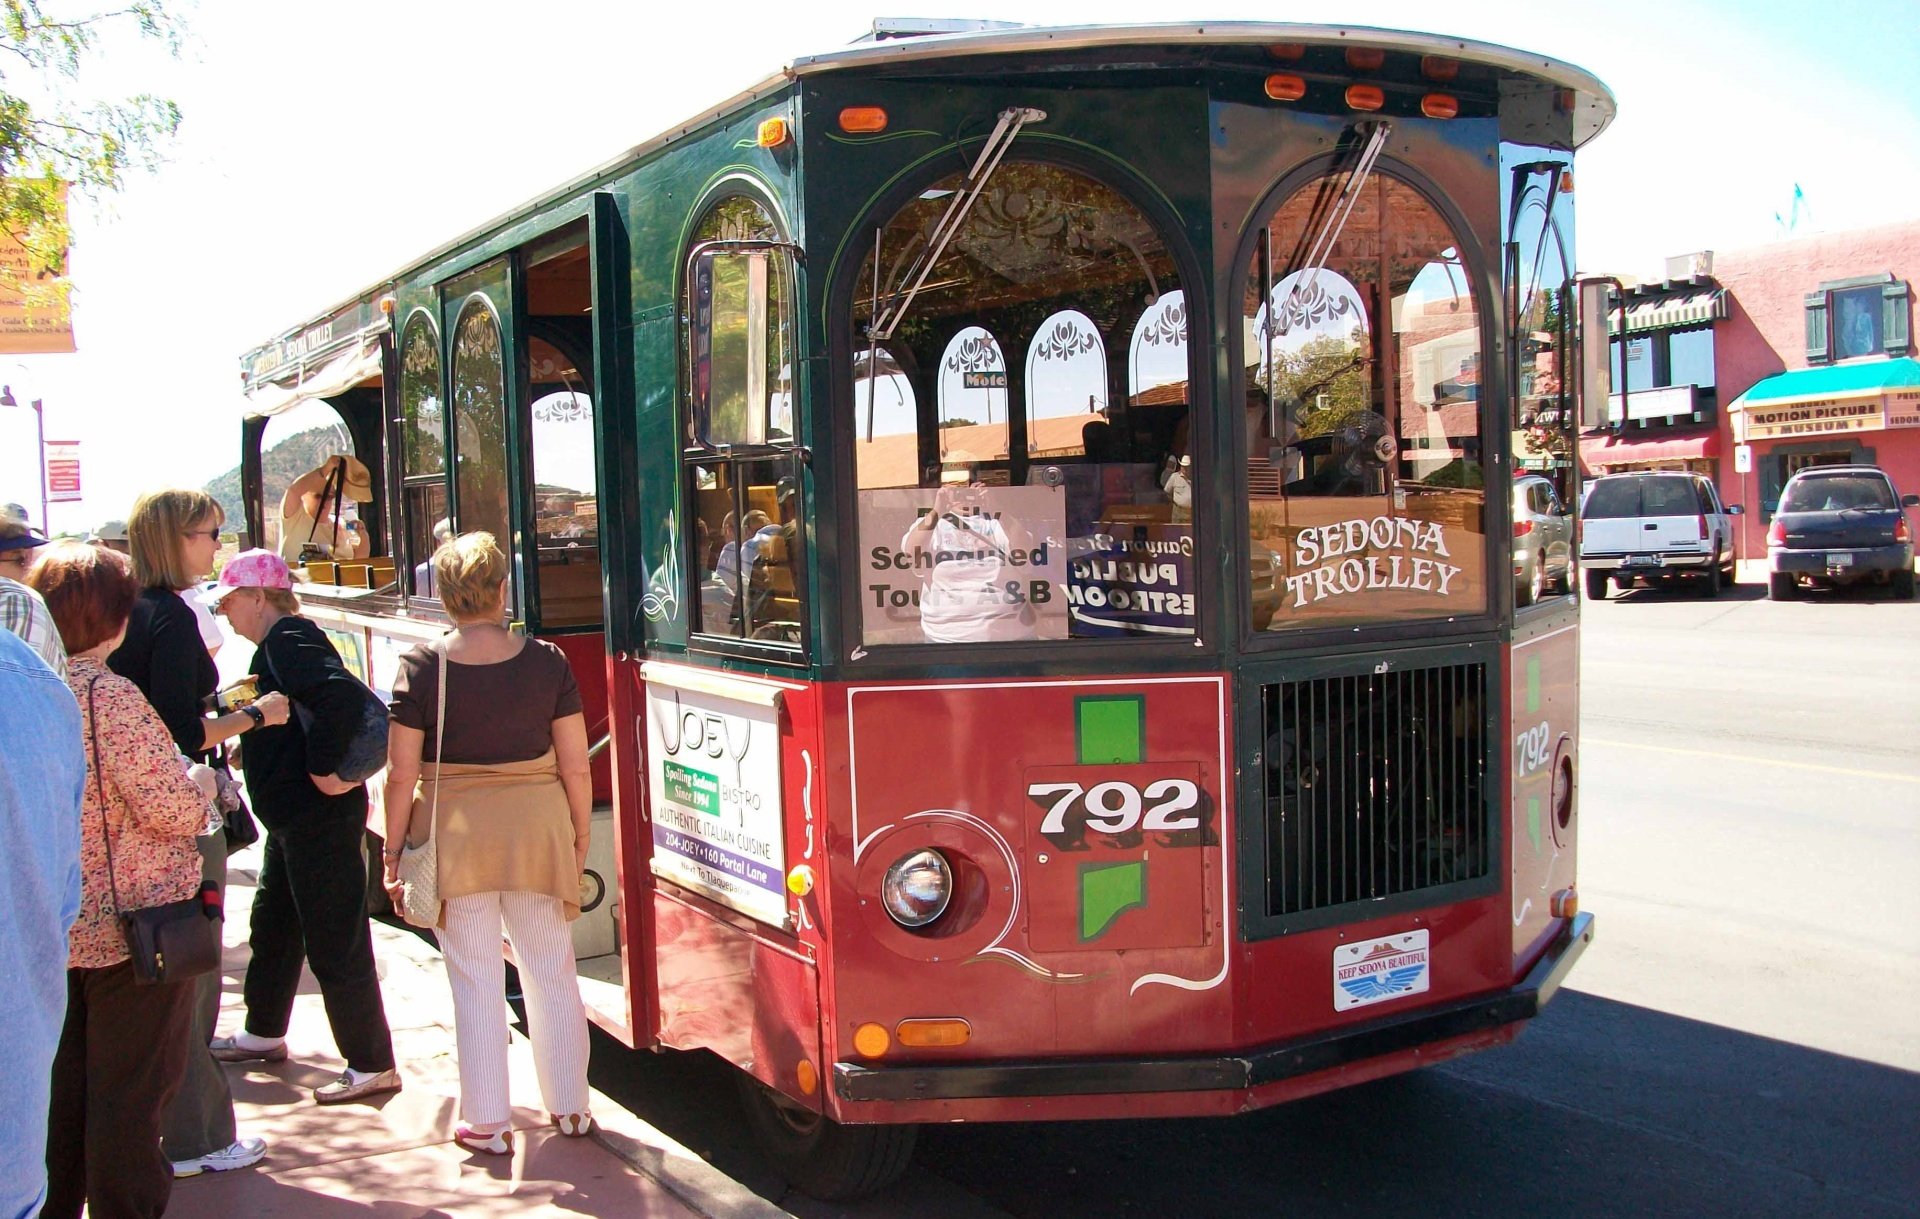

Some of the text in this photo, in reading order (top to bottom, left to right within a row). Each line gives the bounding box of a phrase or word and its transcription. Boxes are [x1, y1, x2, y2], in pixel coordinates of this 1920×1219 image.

[966, 373, 1007, 387] Mote
[1754, 404, 1876, 424] MOTION PICTURE
[1779, 420, 1849, 434] MUSEUM
[1296, 516, 1451, 567] SEDONA
[1286, 555, 1462, 608] TROLLEY
[660, 689, 751, 763] JOEY
[1517, 720, 1550, 778] 792
[665, 764, 717, 793] Spoiling Sedona
[674, 784, 692, 803] Since
[721, 784, 762, 812] BISTRO
[1028, 778, 1200, 834] 792
[659, 807, 772, 860] AUTHENTIC ITALIAN CUISINE
[697, 866, 706, 879] To
[706, 870, 751, 896] Tlaquepae
[719, 852, 745, 877] Portal
[746, 865, 768, 884] Lane
[1338, 951, 1426, 980] KEEP SEDONA BEAUTIFUL
